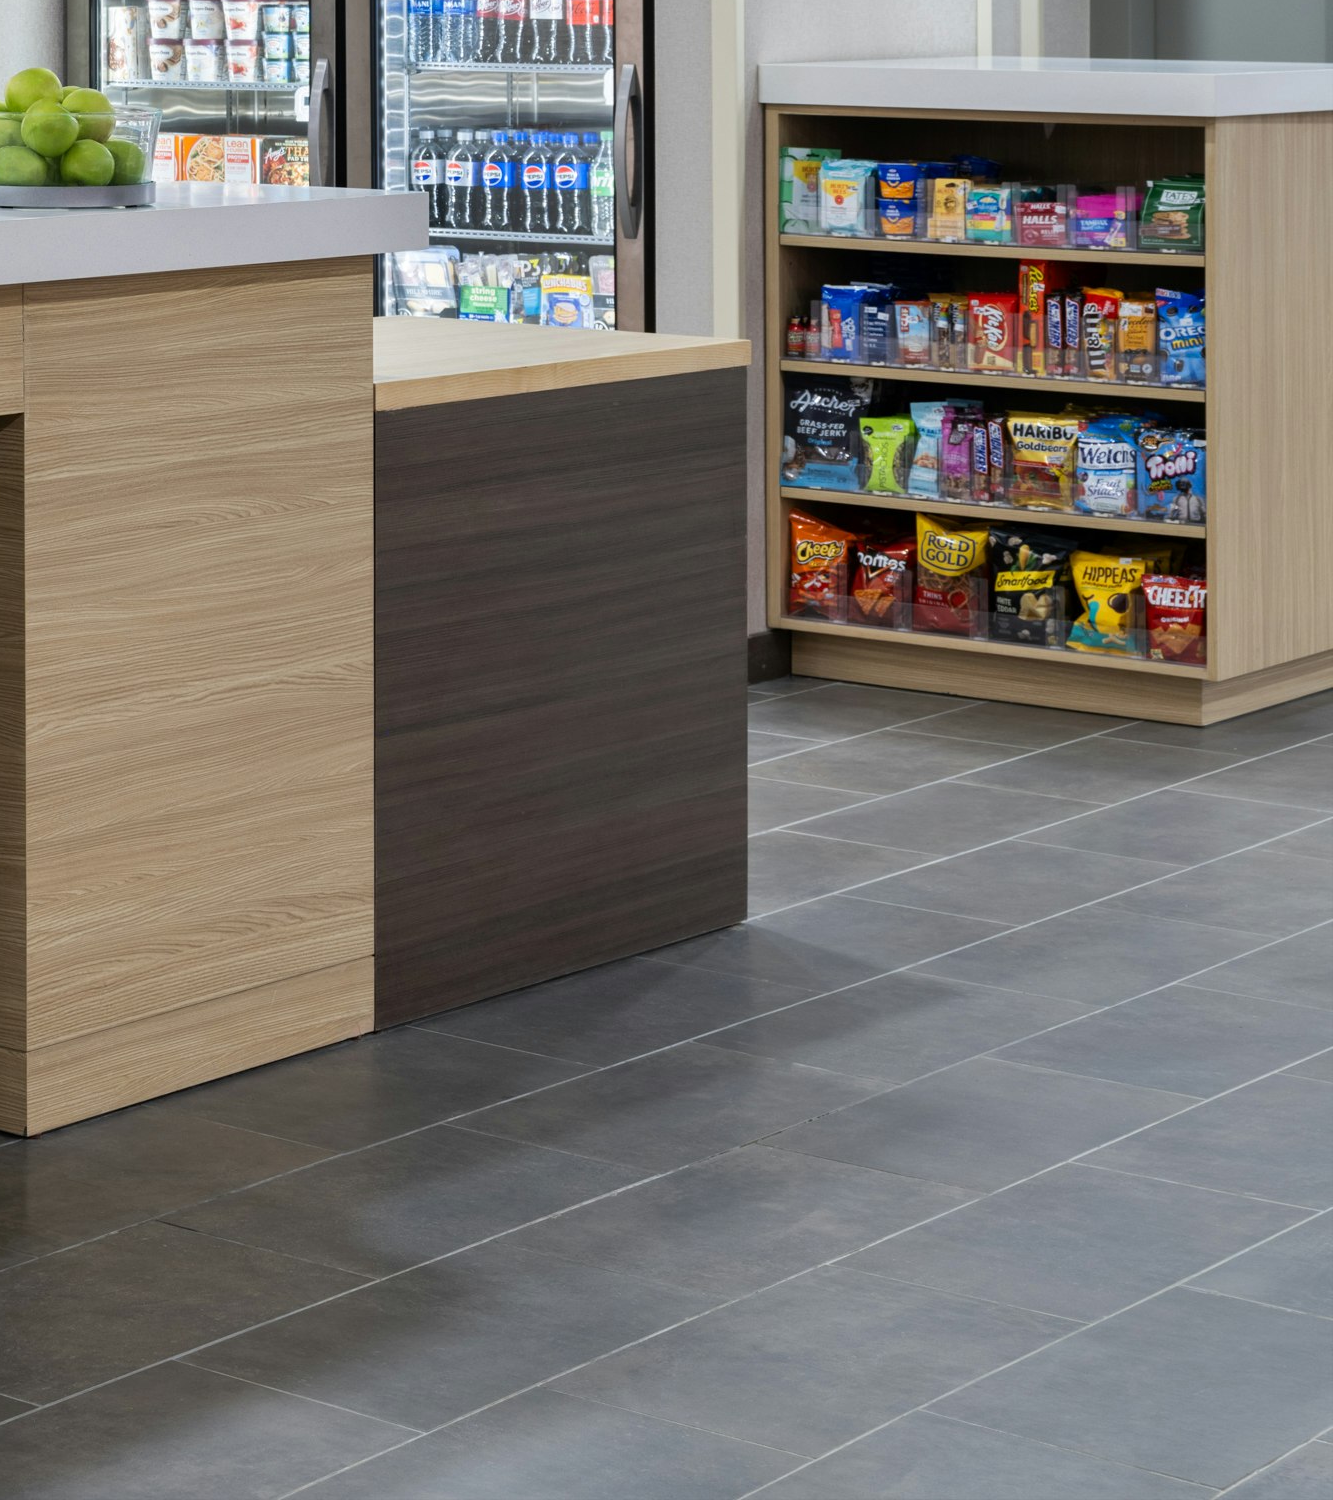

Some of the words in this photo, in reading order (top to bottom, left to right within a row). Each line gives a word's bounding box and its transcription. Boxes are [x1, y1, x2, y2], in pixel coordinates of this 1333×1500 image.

[285, 146, 309, 157] THA
[1022, 215, 1058, 225] HALLS
[521, 259, 541, 277] P3
[471, 287, 496, 296] string
[469, 295, 498, 303] cheese
[1172, 336, 1204, 349] mini
[790, 389, 860, 417] Archer
[799, 419, 845, 430] GRASS-FED
[796, 426, 817, 435] BEEF
[819, 428, 848, 437] JERKY
[1017, 440, 1068, 453] Goldbears
[1146, 451, 1196, 479] Trolli
[927, 531, 970, 553] ROLD
[926, 548, 969, 567] GOLD
[996, 572, 1050, 588] Smartfood
[1082, 566, 1137, 584] HIPPEAS
